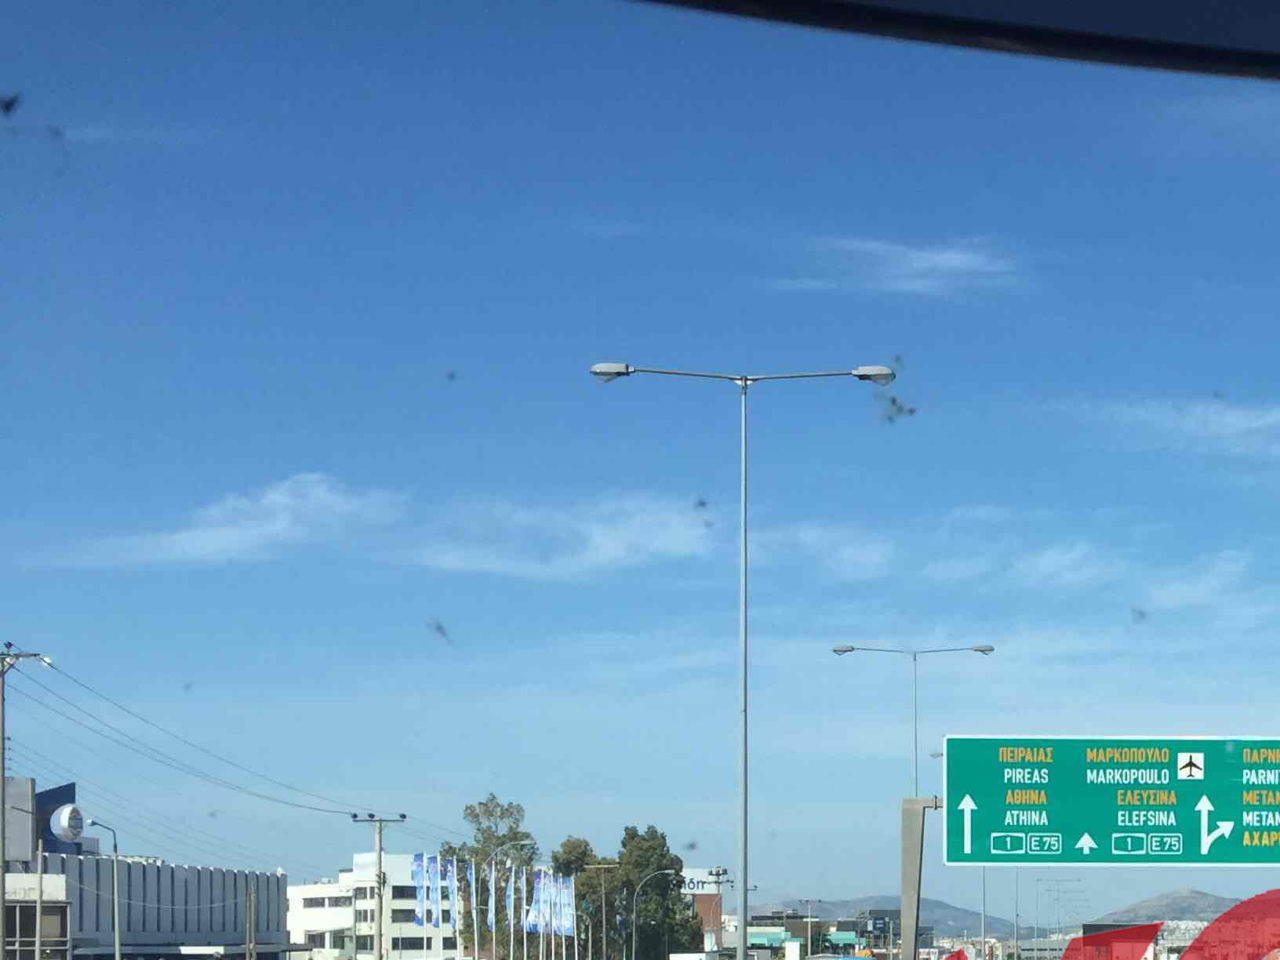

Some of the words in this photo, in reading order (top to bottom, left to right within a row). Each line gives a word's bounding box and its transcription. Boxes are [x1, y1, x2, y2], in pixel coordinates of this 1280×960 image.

[999, 747, 1053, 763] ΠΕΙΡΑΙΑΣ
[1085, 747, 1169, 763] ΜΑΡΚΟΠΟΥΛΟ
[1004, 768, 1049, 783] PIREAS
[1086, 768, 1169, 784] MARKOPOULO
[1006, 789, 1047, 805] ΑΘΗΝΑ
[1117, 789, 1177, 805] ΕΛΕΥΣΙΝΑ
[1004, 810, 1048, 826] ATHINA
[1117, 810, 1176, 826] ELEFSINA
[1005, 837, 1011, 850] 1
[1031, 837, 1040, 850] E
[1042, 837, 1059, 850] 75
[1126, 837, 1132, 851] 1
[1151, 837, 1161, 851] E
[1163, 837, 1180, 851] 75
